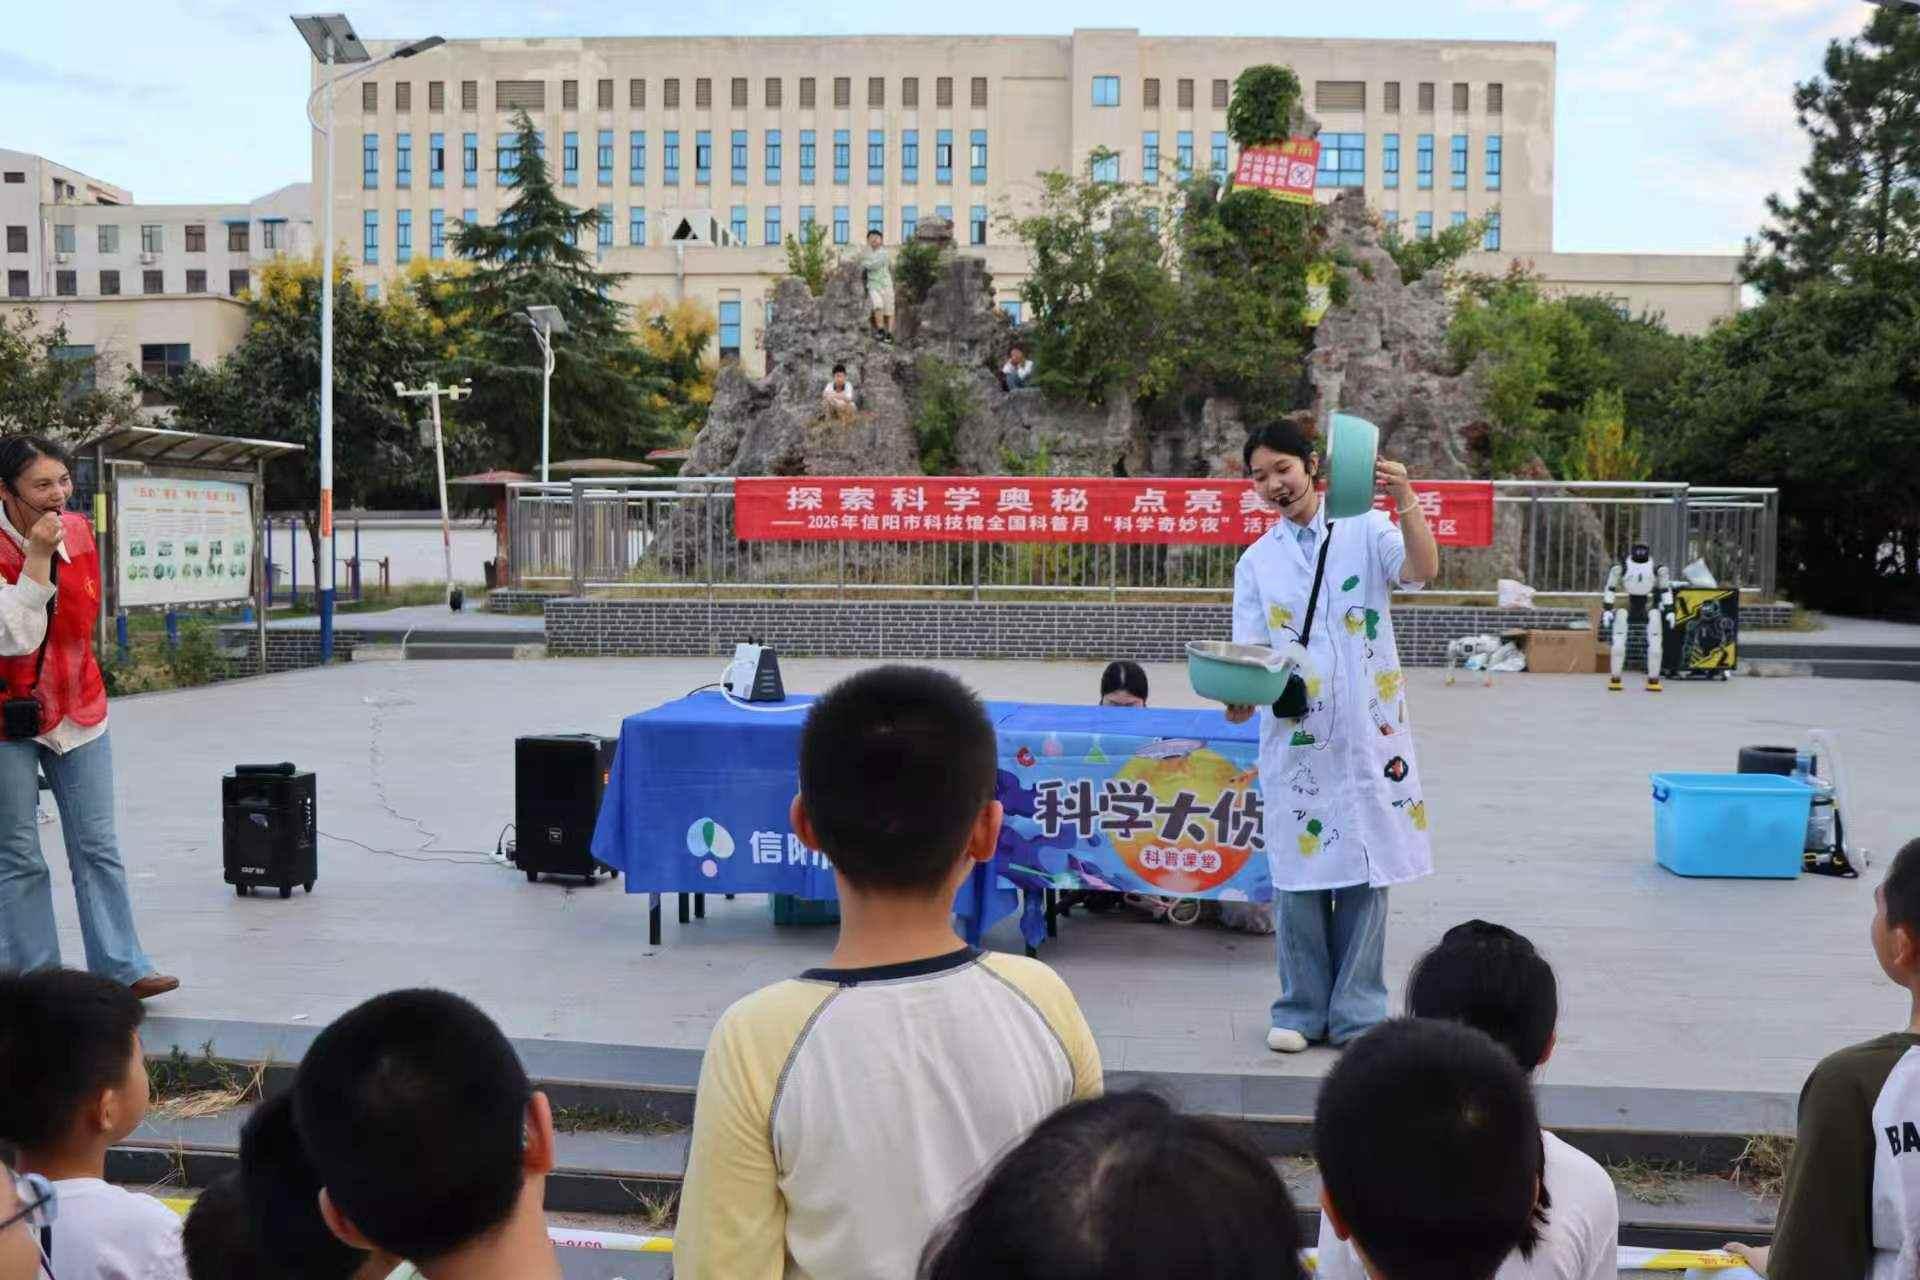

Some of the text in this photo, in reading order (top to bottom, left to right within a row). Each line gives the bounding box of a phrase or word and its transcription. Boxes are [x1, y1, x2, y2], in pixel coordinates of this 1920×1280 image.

[786, 487, 1088, 512] 探索科学奥秘
[1143, 849, 1217, 870] 科普课堂
